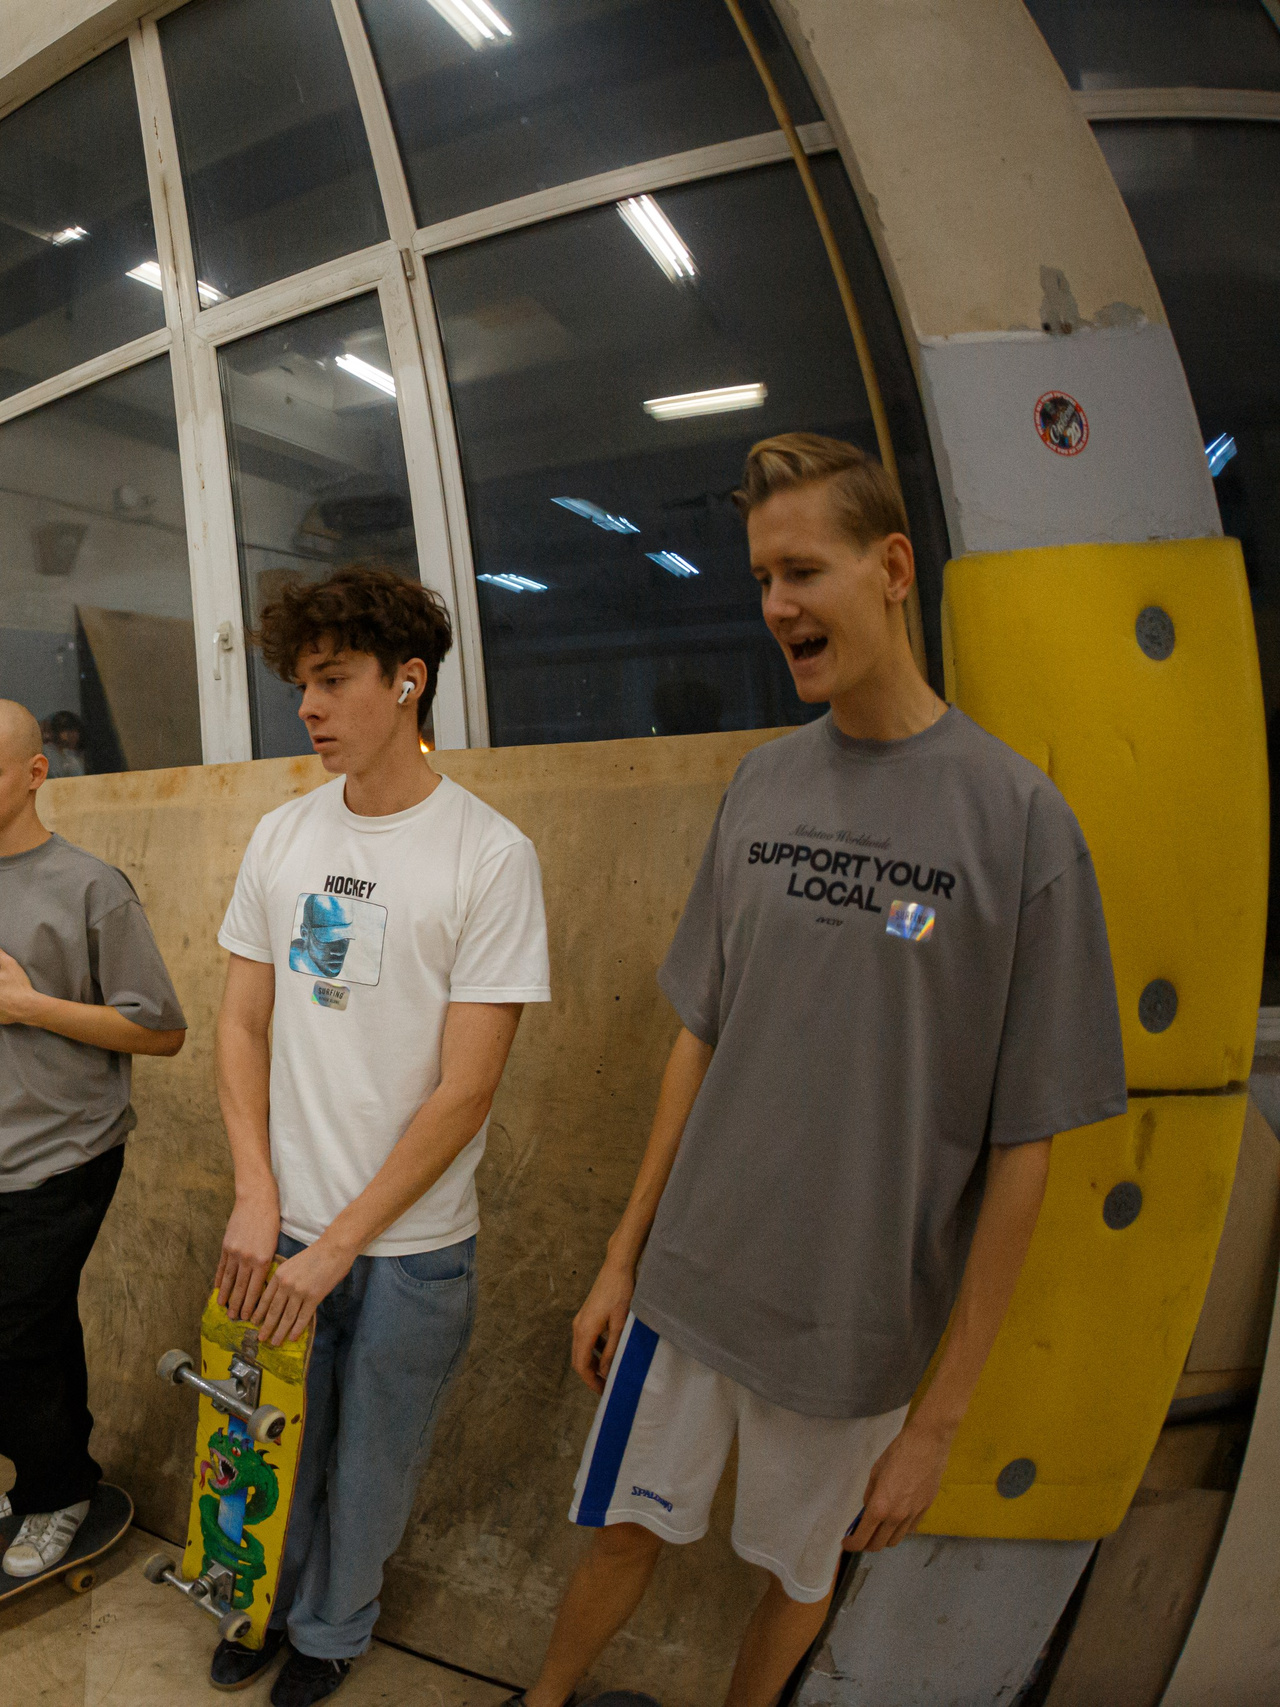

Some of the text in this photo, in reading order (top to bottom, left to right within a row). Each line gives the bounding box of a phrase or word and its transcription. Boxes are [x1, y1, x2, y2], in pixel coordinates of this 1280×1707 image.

[323, 875, 377, 899] HOCKEY
[748, 842, 956, 900] SUPPORT YOUR
[787, 873, 882, 913] LOCAL
[317, 987, 345, 1000] SURFING
